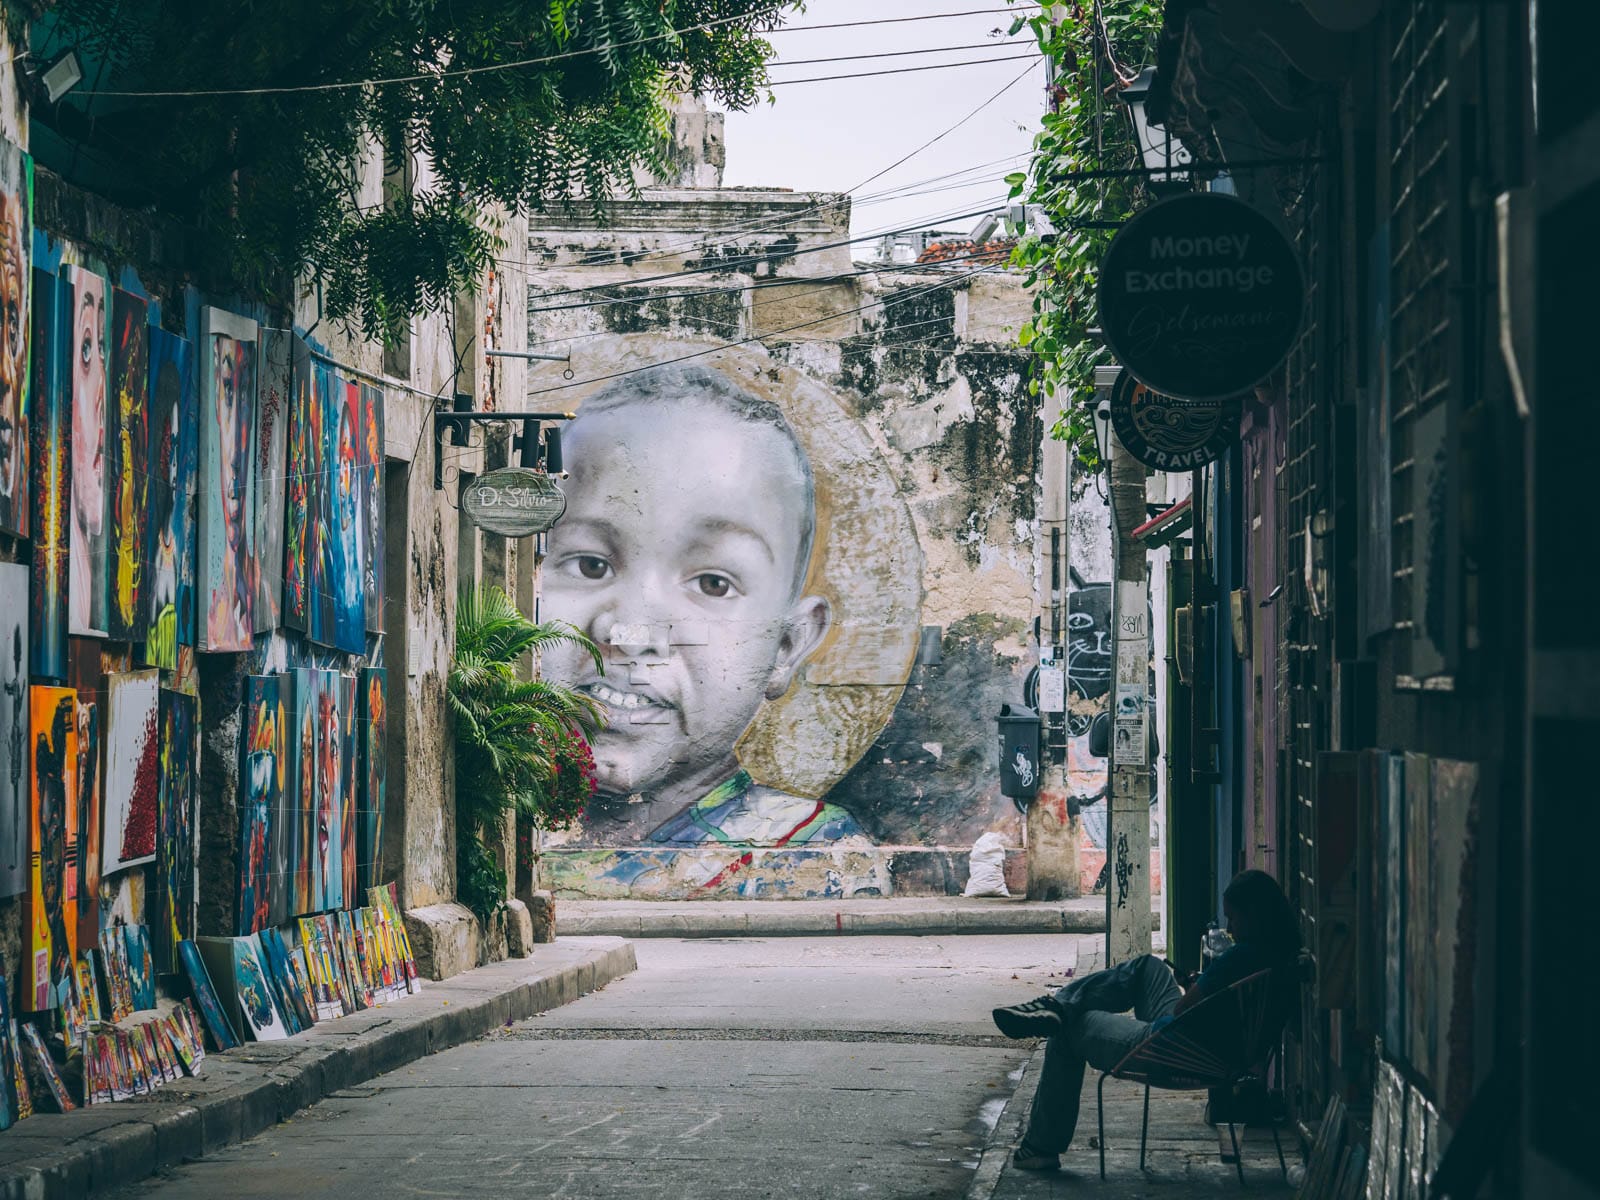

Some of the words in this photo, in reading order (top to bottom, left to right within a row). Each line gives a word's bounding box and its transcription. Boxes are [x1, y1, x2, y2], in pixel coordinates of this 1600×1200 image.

[1150, 232, 1250, 259] Money
[1125, 265, 1273, 293] Exchange
[1143, 445, 1216, 467] TRAVEL
[478, 486, 502, 507] Di
[505, 485, 552, 508] Silvio
